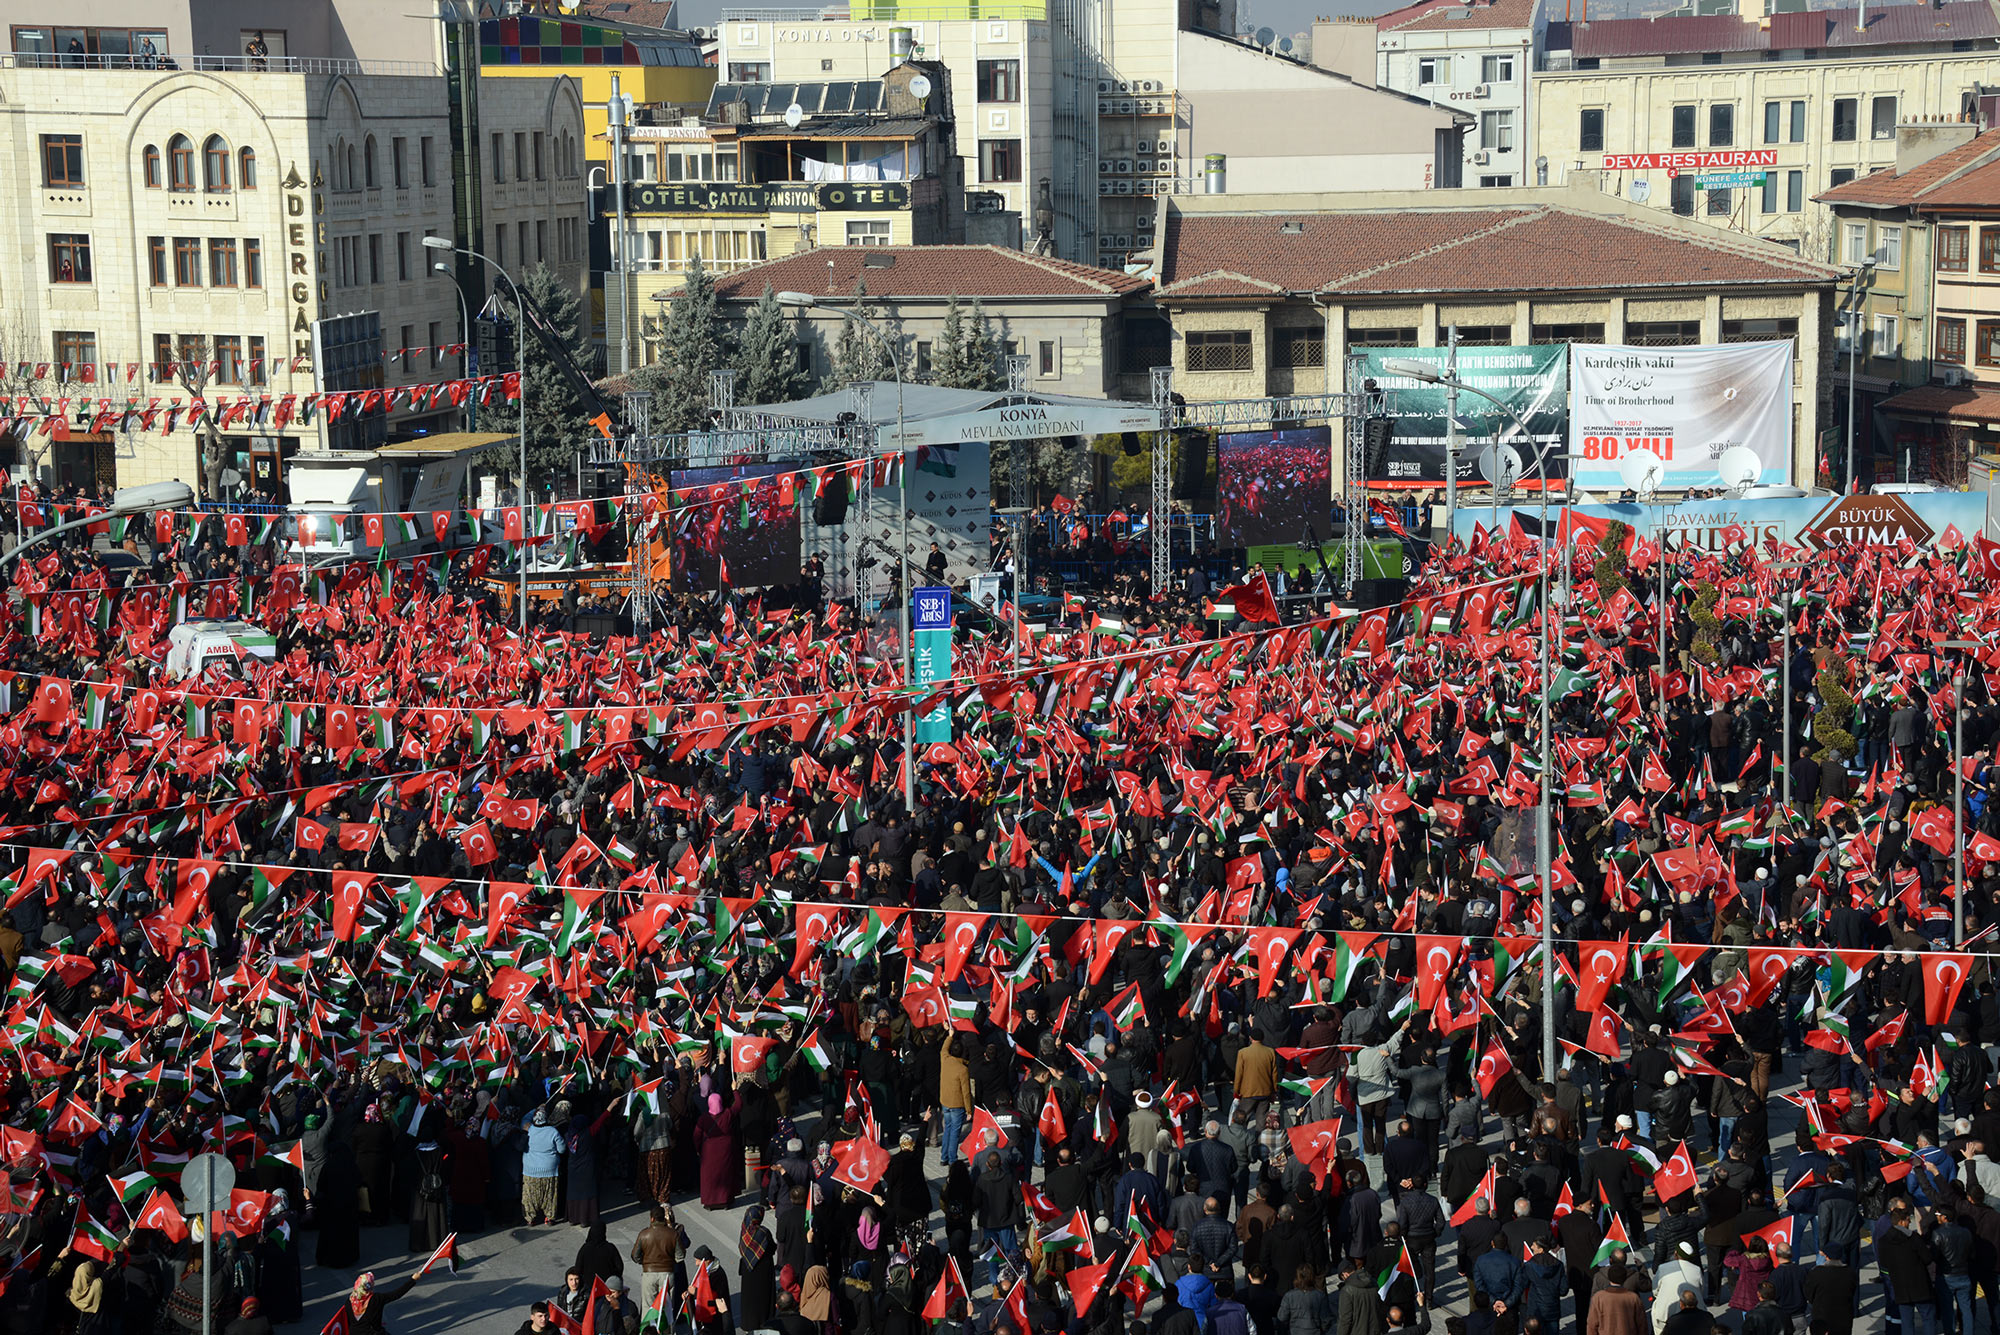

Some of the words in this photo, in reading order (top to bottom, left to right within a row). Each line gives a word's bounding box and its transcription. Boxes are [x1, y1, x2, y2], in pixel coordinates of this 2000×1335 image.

[777, 28, 832, 42] KONYA
[1603, 155, 1653, 169] DEVA
[1659, 150, 1777, 167] RESTAURAN
[1669, 170, 1676, 178] 2
[1696, 174, 1731, 183] KÜNEFE
[1738, 173, 1761, 181] CAFE
[1703, 181, 1754, 190] RESTAURANT
[641, 190, 700, 205] OTEL
[708, 191, 758, 209] ÇATAL
[829, 189, 901, 204] OTEL
[1585, 356, 1641, 372] Kardeşlik
[1645, 356, 1674, 369] vakti
[1585, 395, 1606, 405] Time
[1607, 396, 1617, 405] of
[1618, 395, 1674, 406] Brotherhood
[999, 408, 1047, 423] KONYA
[961, 424, 1023, 440] MEVLANA
[1026, 420, 1084, 436] MEYDANI
[1666, 511, 1738, 526] DAVAMIZ
[1839, 507, 1897, 524] BÜYÜK
[526, 582, 554, 591] EMEL
